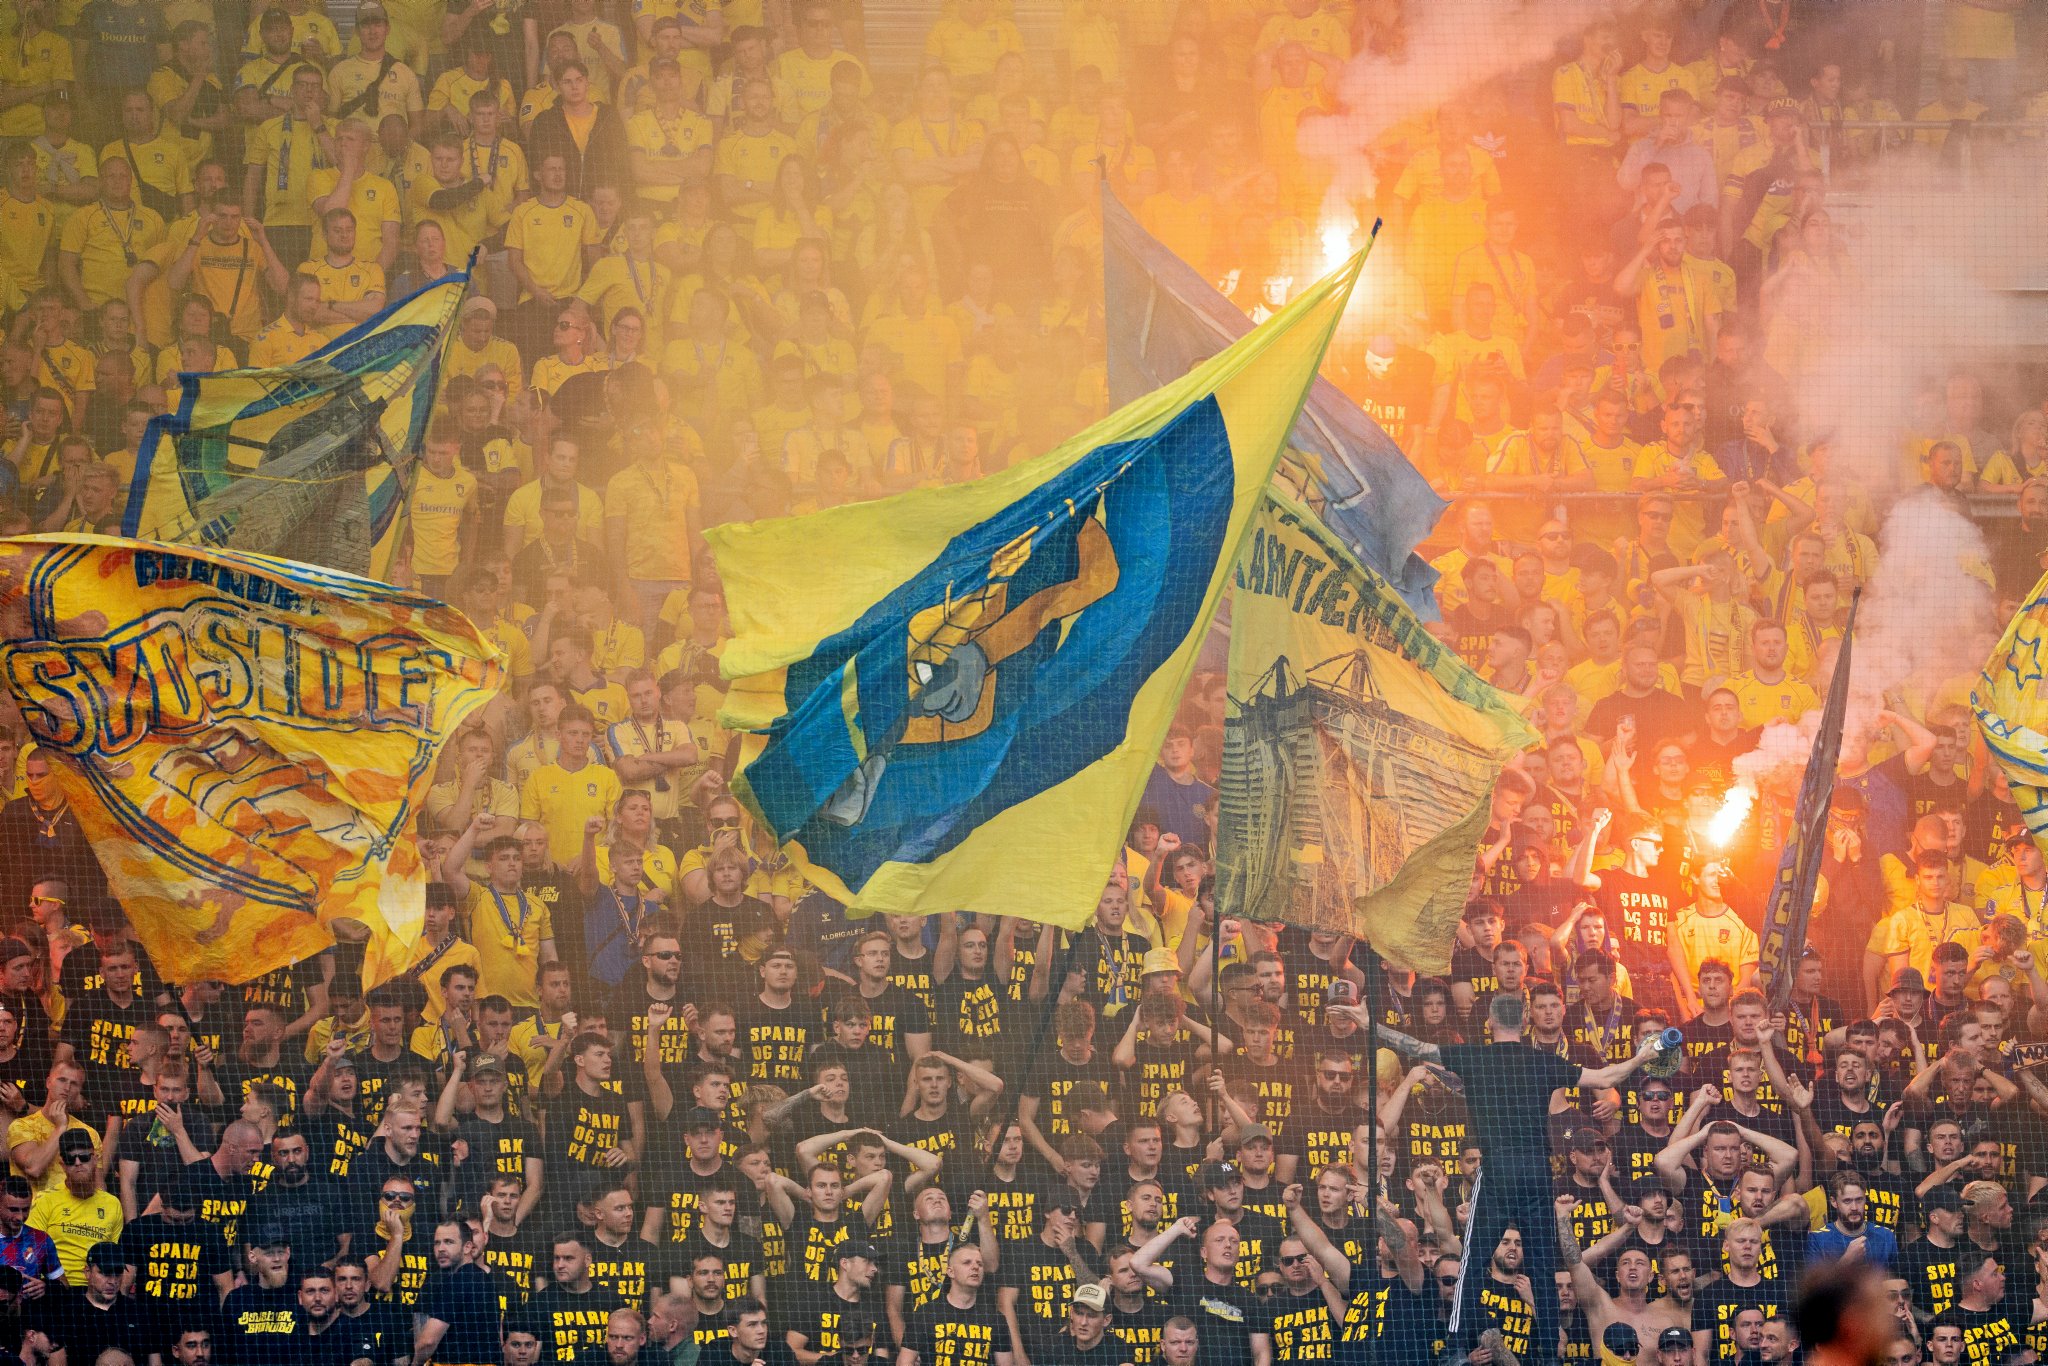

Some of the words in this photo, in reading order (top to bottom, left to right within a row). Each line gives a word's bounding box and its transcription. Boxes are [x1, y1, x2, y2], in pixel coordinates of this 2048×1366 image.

[821, 930, 845, 942] ALDRIG
[1624, 925, 1643, 942] PÅ
[1471, 977, 1498, 992] SPA
[91, 1019, 135, 1040] SPAR
[751, 1026, 806, 1044] SPARK
[752, 1045, 771, 1060] OG
[574, 1126, 594, 1145] OG
[1308, 1132, 1352, 1147] SPAR
[1410, 1123, 1465, 1139] SPARK
[1411, 1140, 1435, 1156] OG
[496, 1158, 523, 1174] SLÅ
[988, 1192, 1035, 1208] PARK
[150, 1243, 201, 1260] SPARK
[483, 1251, 534, 1270] PARK
[149, 1263, 168, 1278] OG
[175, 1262, 198, 1281] SLÅ
[1031, 1264, 1076, 1282] SPAR
[1031, 1285, 1053, 1300] OG
[1931, 1282, 1953, 1299] OG
[553, 1311, 609, 1327] SPARK
[1274, 1306, 1329, 1330] SPARK
[555, 1329, 579, 1346] OG
[934, 1323, 992, 1343] SPARK
[1107, 1327, 1162, 1344] PARK
[1275, 1331, 1294, 1348] OG
[1302, 1322, 1332, 1342] SLÅ
[935, 1340, 956, 1358] OG
[1299, 1343, 1332, 1360] FCK!
